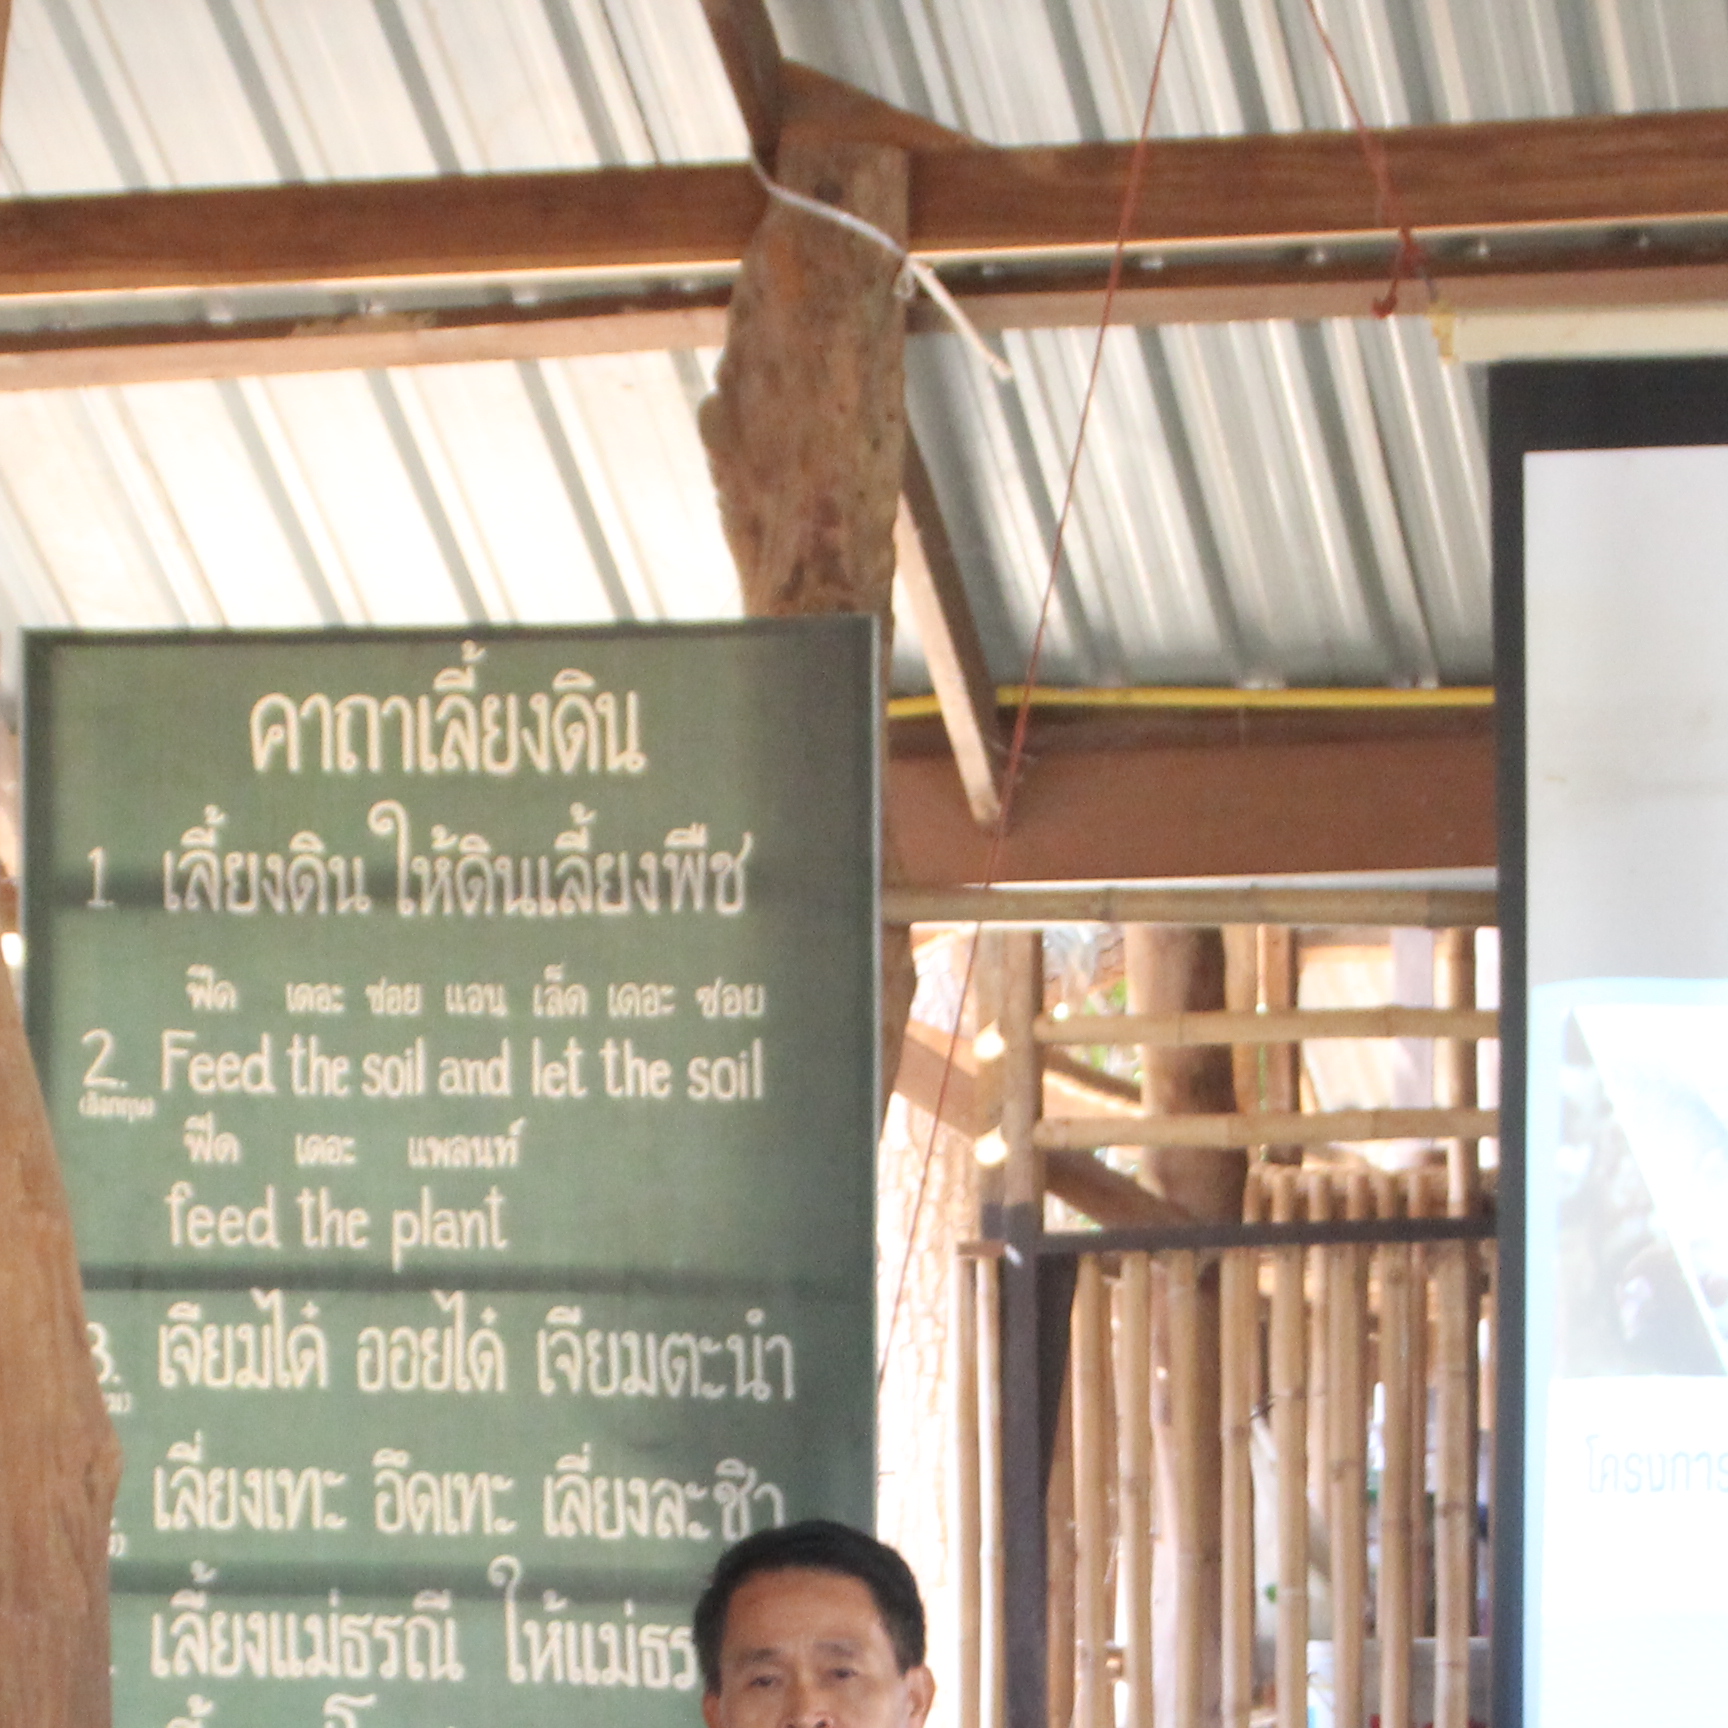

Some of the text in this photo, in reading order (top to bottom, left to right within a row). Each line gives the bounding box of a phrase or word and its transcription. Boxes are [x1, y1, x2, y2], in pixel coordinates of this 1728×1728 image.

[249, 640, 648, 776] คาถาเลี้ยงดิน
[162, 802, 372, 915] เลี้ยงดิน
[367, 799, 753, 918] ให้ดินเลี้ยงพืช
[444, 982, 510, 1019] แอน
[160, 1028, 278, 1096] Feed
[285, 1033, 351, 1098] the
[360, 1036, 427, 1100] soil
[437, 1037, 513, 1098] and
[530, 1036, 588, 1100] let
[598, 1037, 673, 1100] the
[686, 1038, 763, 1102] soil
[164, 1179, 509, 1269] feed the plant
[534, 1303, 793, 1401] เจียมตะนำ
[152, 1430, 348, 1532] เลี่ยงเทะ
[148, 1554, 697, 1691] เลี้ยงแม่ธรณี ให้แม่ธร
